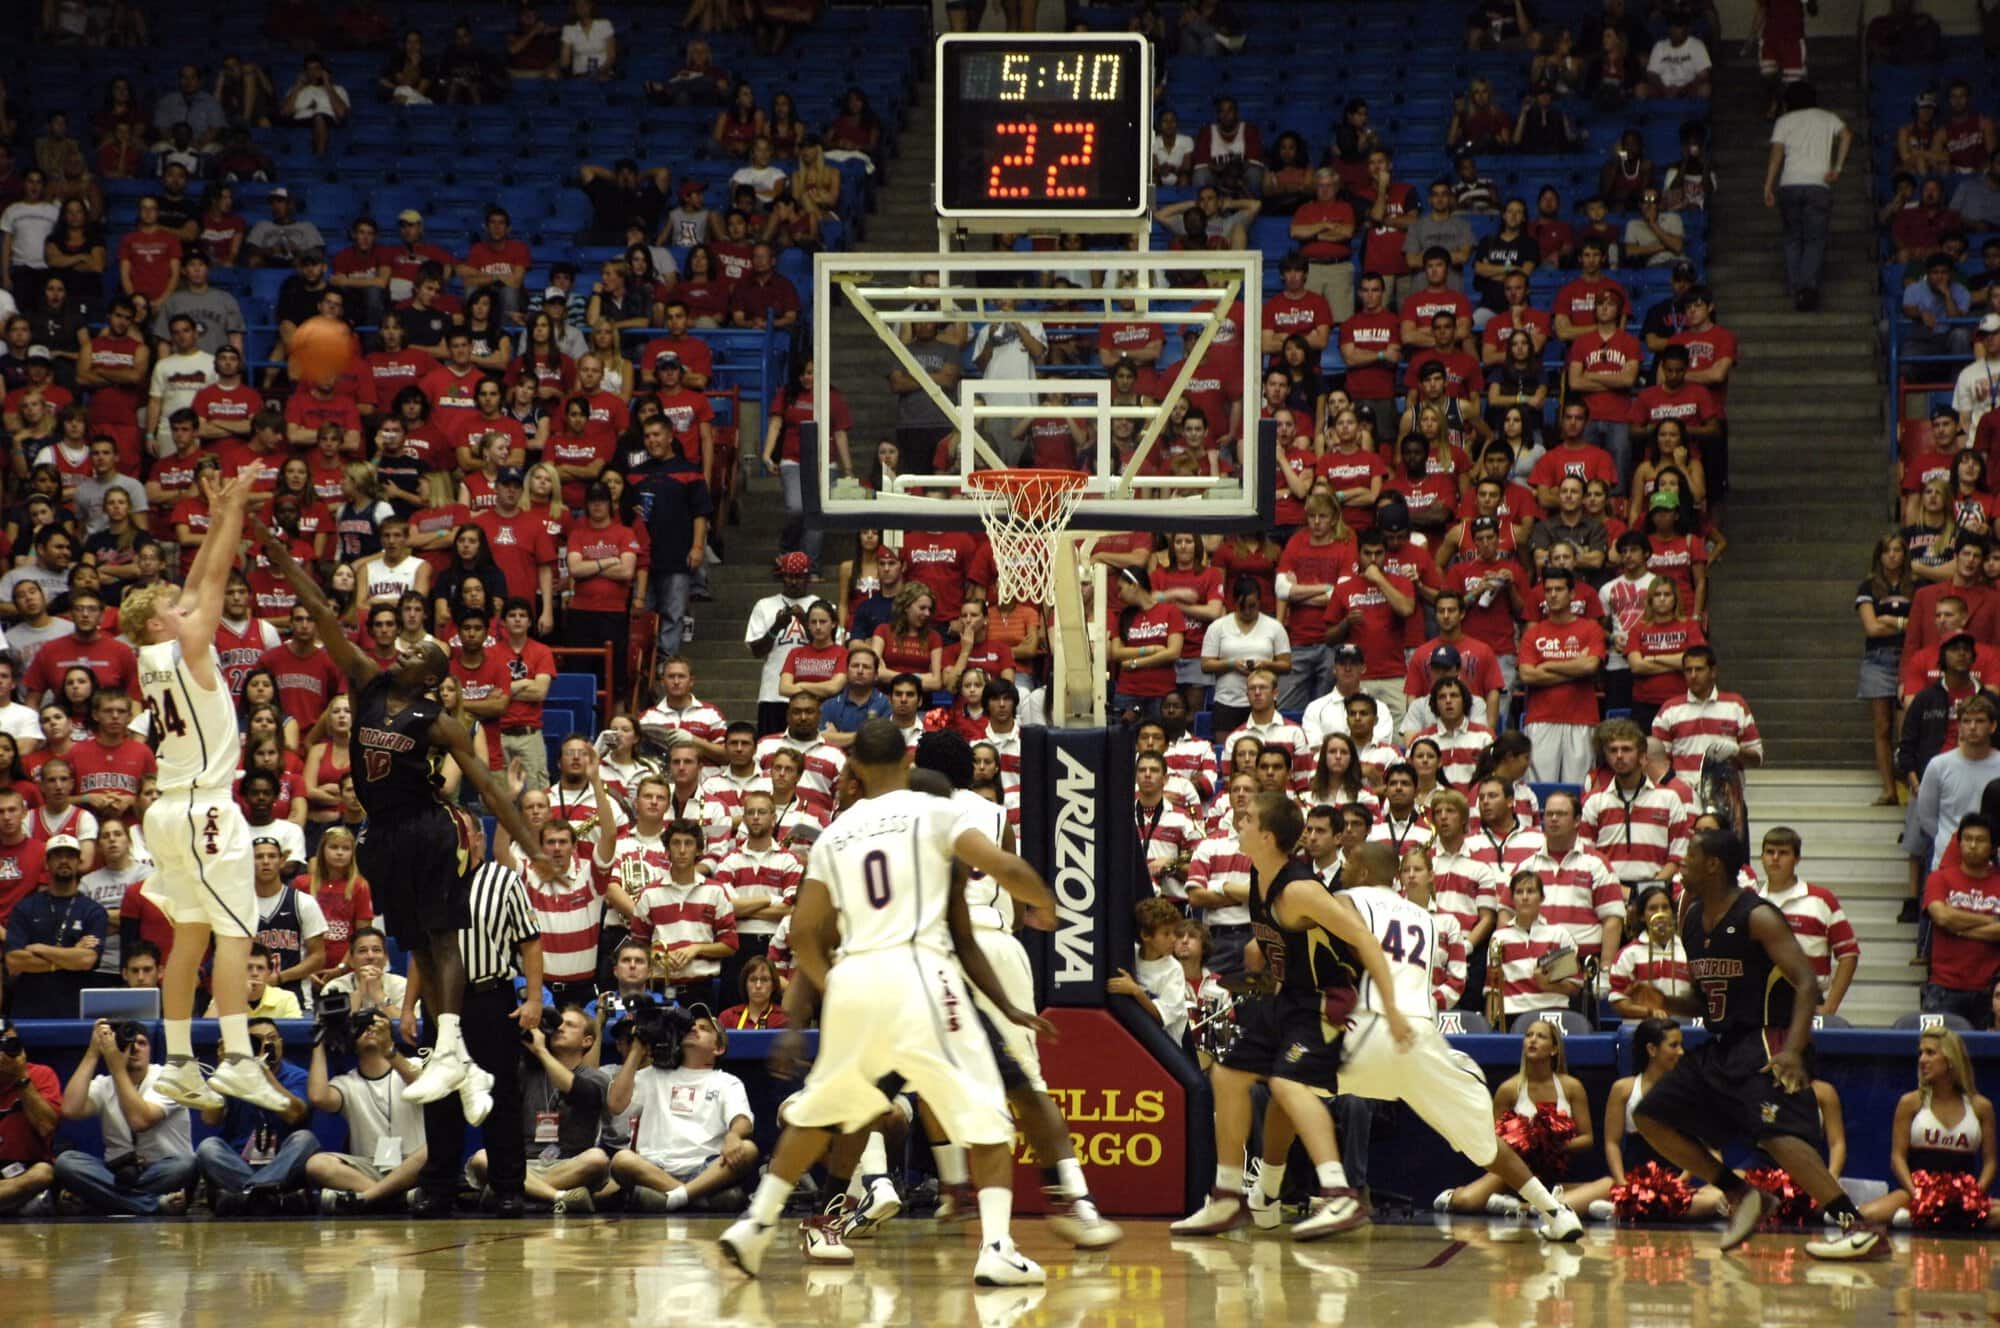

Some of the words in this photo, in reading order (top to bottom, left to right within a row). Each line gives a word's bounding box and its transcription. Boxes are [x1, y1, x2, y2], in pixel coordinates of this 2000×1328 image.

[1000, 54, 1120, 100] 5:40
[989, 122, 1095, 198] 22
[1587, 349, 1627, 368] ARIONA
[1536, 635, 1561, 651] Cat
[1640, 632, 1687, 645] ARIZONA
[80, 772, 137, 793] ARIZONA
[202, 805, 218, 855] CATS
[864, 850, 891, 909] 0
[1054, 747, 1096, 983] ARIZONA
[256, 929, 298, 952] ZONA
[1381, 920, 1426, 968] 42
[1010, 1088, 1165, 1123] ELLS
